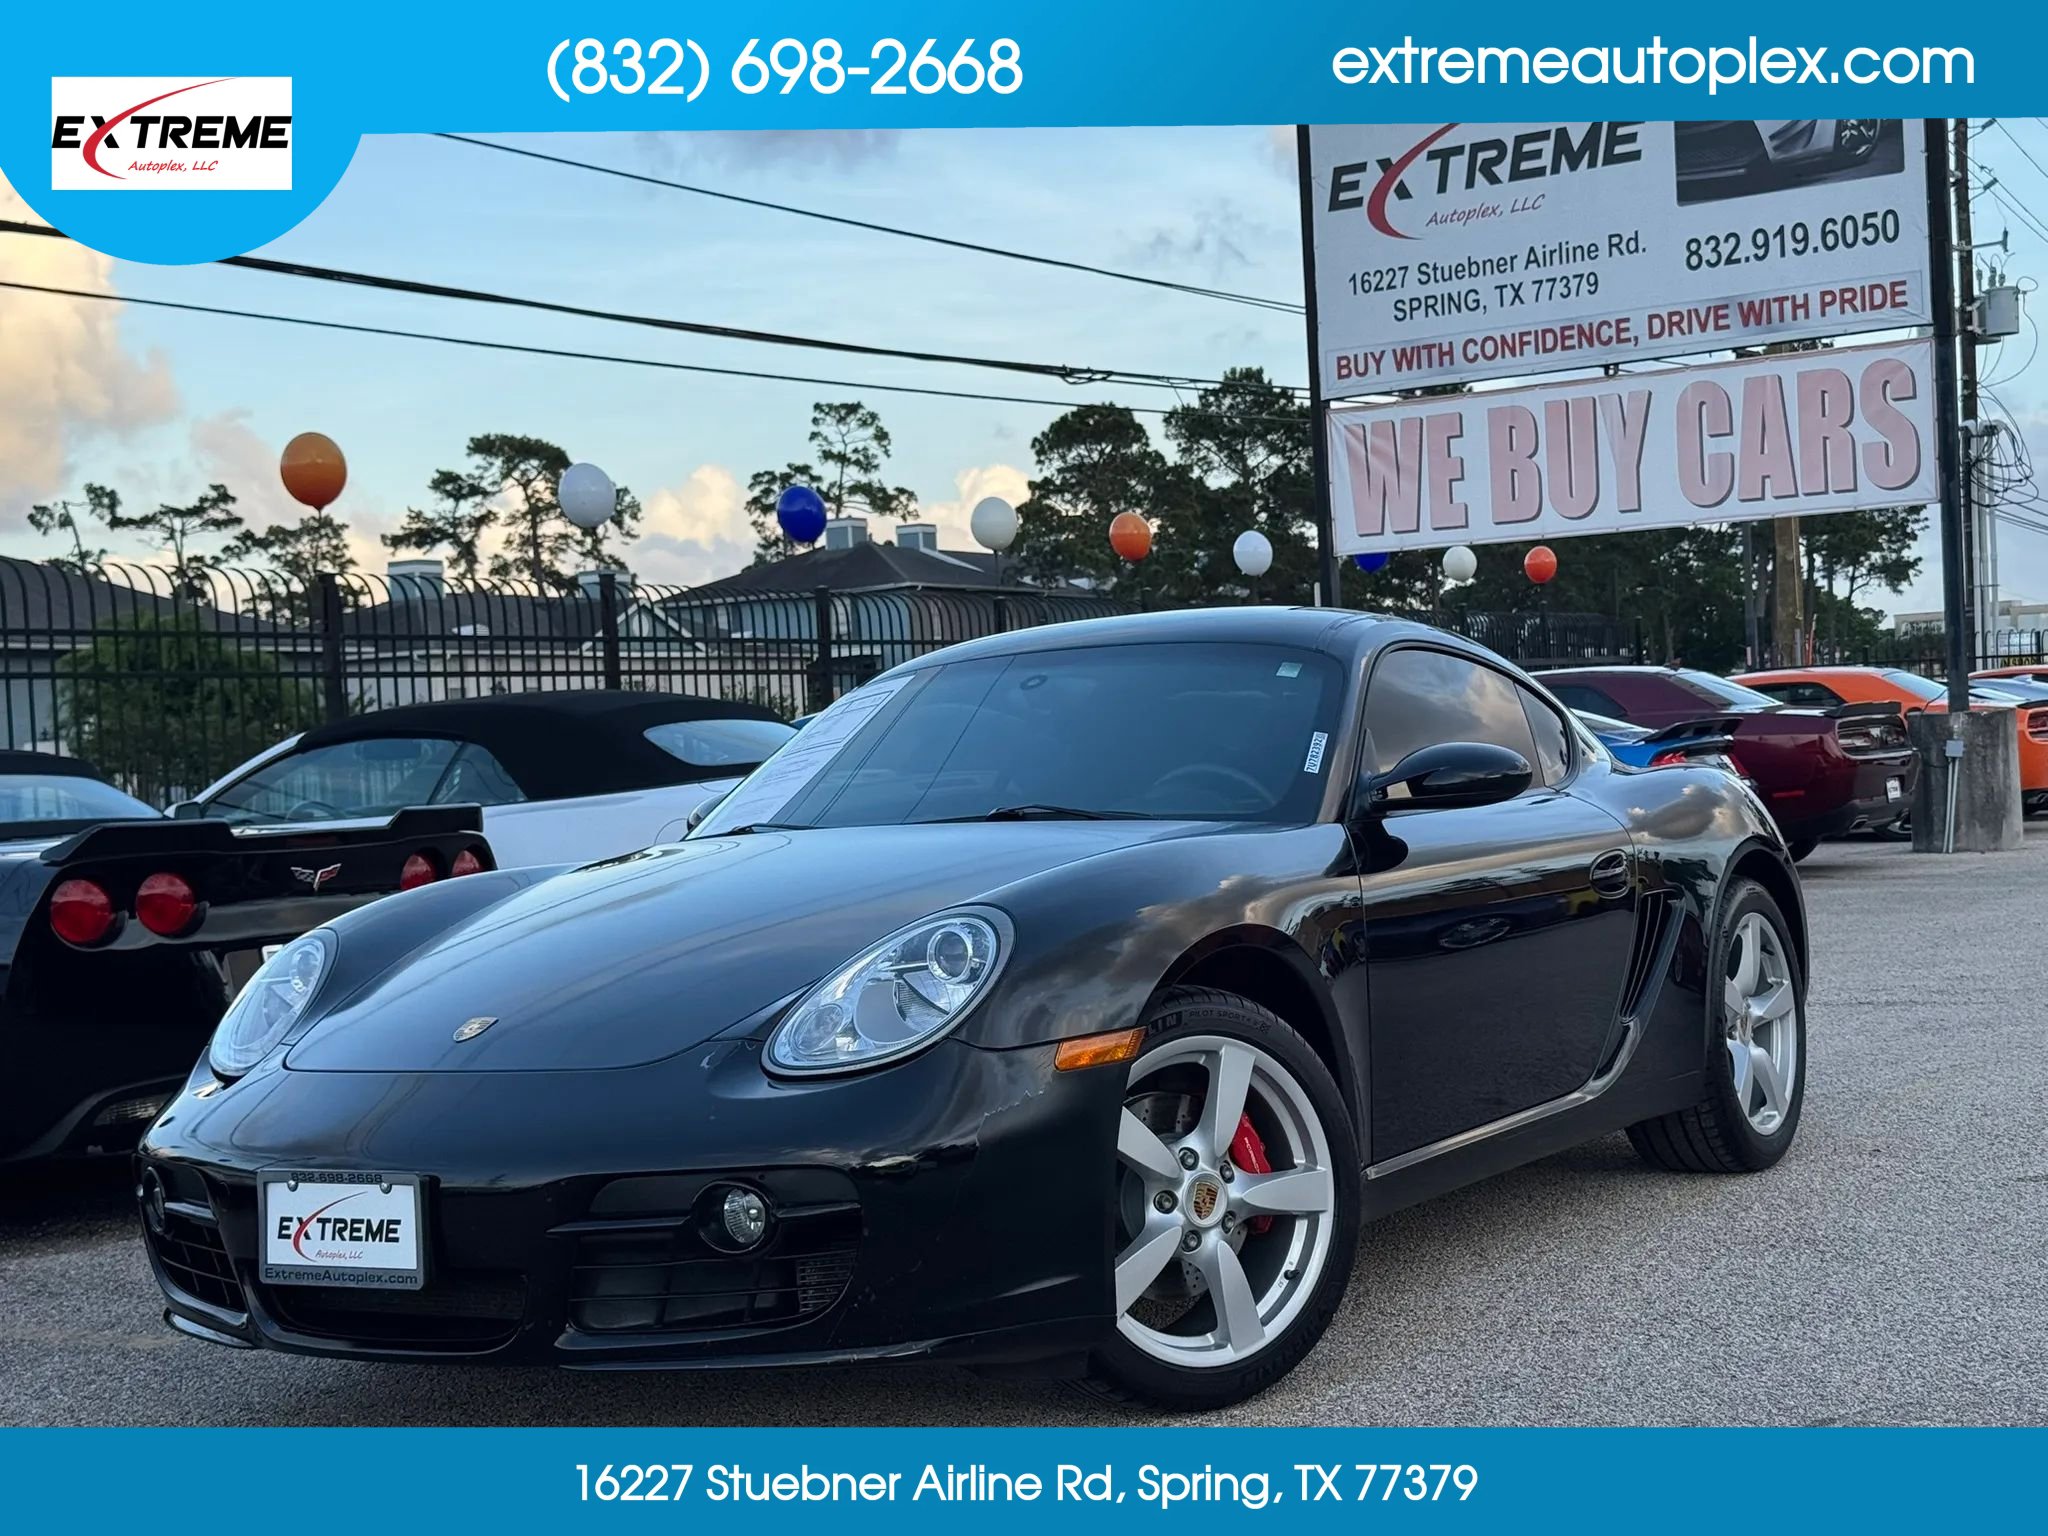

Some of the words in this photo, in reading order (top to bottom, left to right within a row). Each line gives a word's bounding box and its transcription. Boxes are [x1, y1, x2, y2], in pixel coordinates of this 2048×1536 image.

[1328, 121, 1646, 212] EXTREME
[1425, 203, 1504, 227] Autoplex,
[1511, 194, 1546, 213] LLC
[1685, 209, 1900, 271] 832.919.6050
[1348, 266, 1410, 296] 16227
[1417, 253, 1518, 285] Stuebner
[1524, 240, 1600, 271] Airline
[1608, 231, 1647, 258] Rd.
[1393, 289, 1488, 322] SPRING,
[1495, 282, 1524, 308] TX
[1532, 272, 1599, 304] 77379
[1336, 351, 1386, 380] BUY
[1391, 342, 1455, 372] WITH
[1462, 317, 1639, 365] CONFIDENCE,
[1648, 304, 1730, 340] DRIVE
[1737, 293, 1810, 327] WITH
[1819, 280, 1908, 317] PRIDE
[1344, 411, 1469, 536] WE
[1487, 389, 1652, 526] BUY
[1676, 358, 1921, 508] CARS
[1189, 1009, 1214, 1018] PILOT
[290, 1172, 383, 1183] 832-698-2668
[277, 1216, 402, 1243] EXTREME
[349, 1251, 363, 1259] LLC
[265, 1267, 418, 1285] ExtremeAutoplex.com
